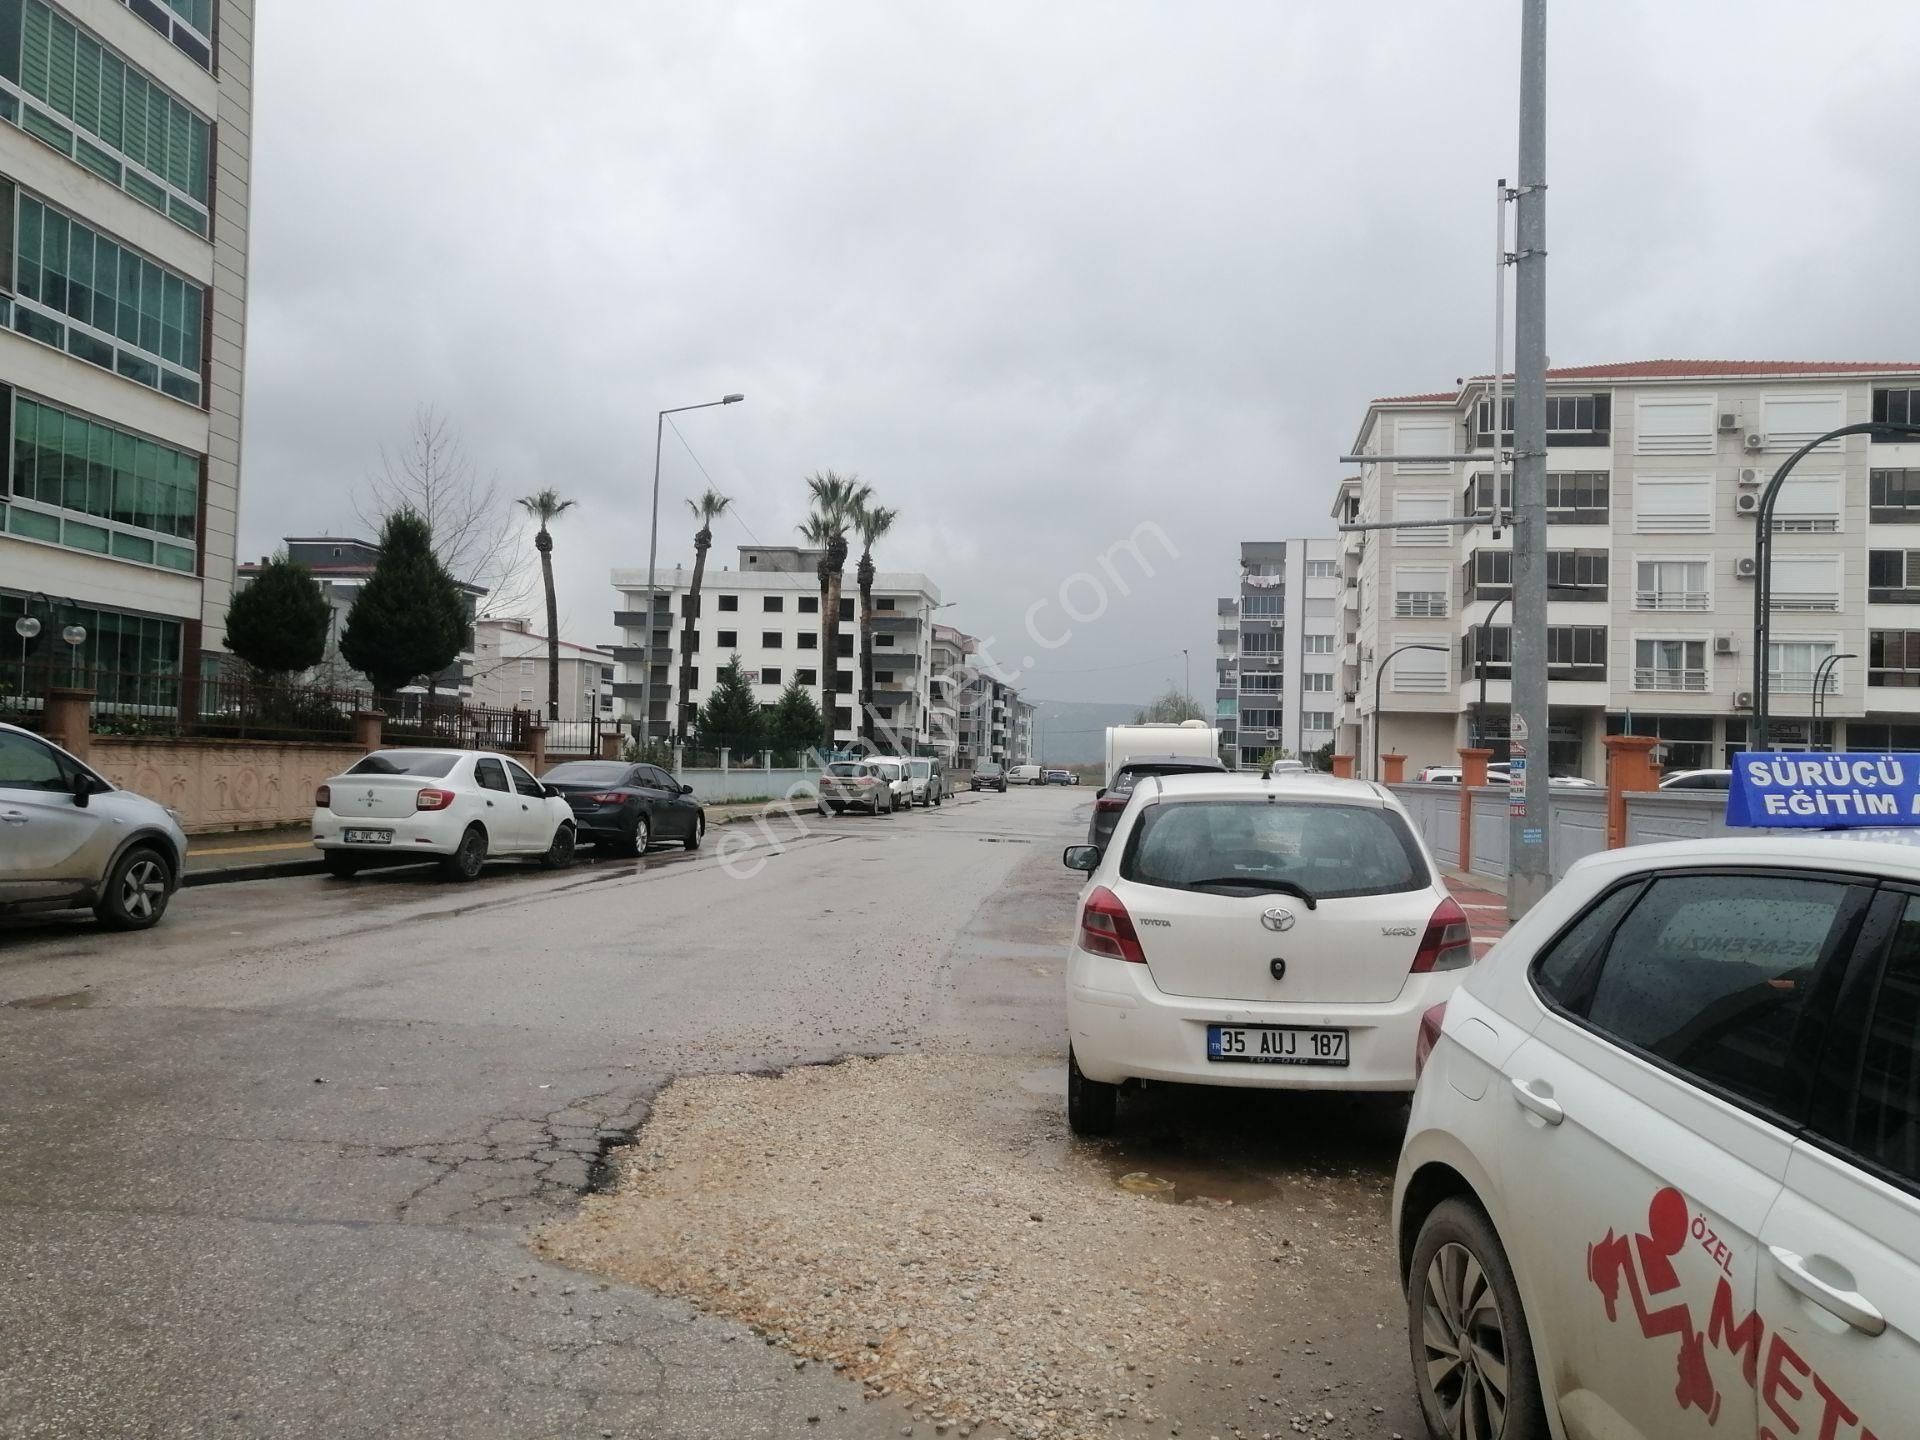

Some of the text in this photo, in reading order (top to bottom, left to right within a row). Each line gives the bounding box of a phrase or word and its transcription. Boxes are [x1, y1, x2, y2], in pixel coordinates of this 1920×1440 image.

[1748, 755, 1904, 787] SÜRÜCÜ
[1763, 789, 1899, 815] EĞİTİM
[1139, 918, 1171, 927] TOYOTA
[1212, 1042, 1221, 1050] TR
[1221, 1031, 1344, 1057] 35 AUJ 187
[1691, 1213, 1734, 1277] ÖZEL
[1708, 1275, 1879, 1440] MET
